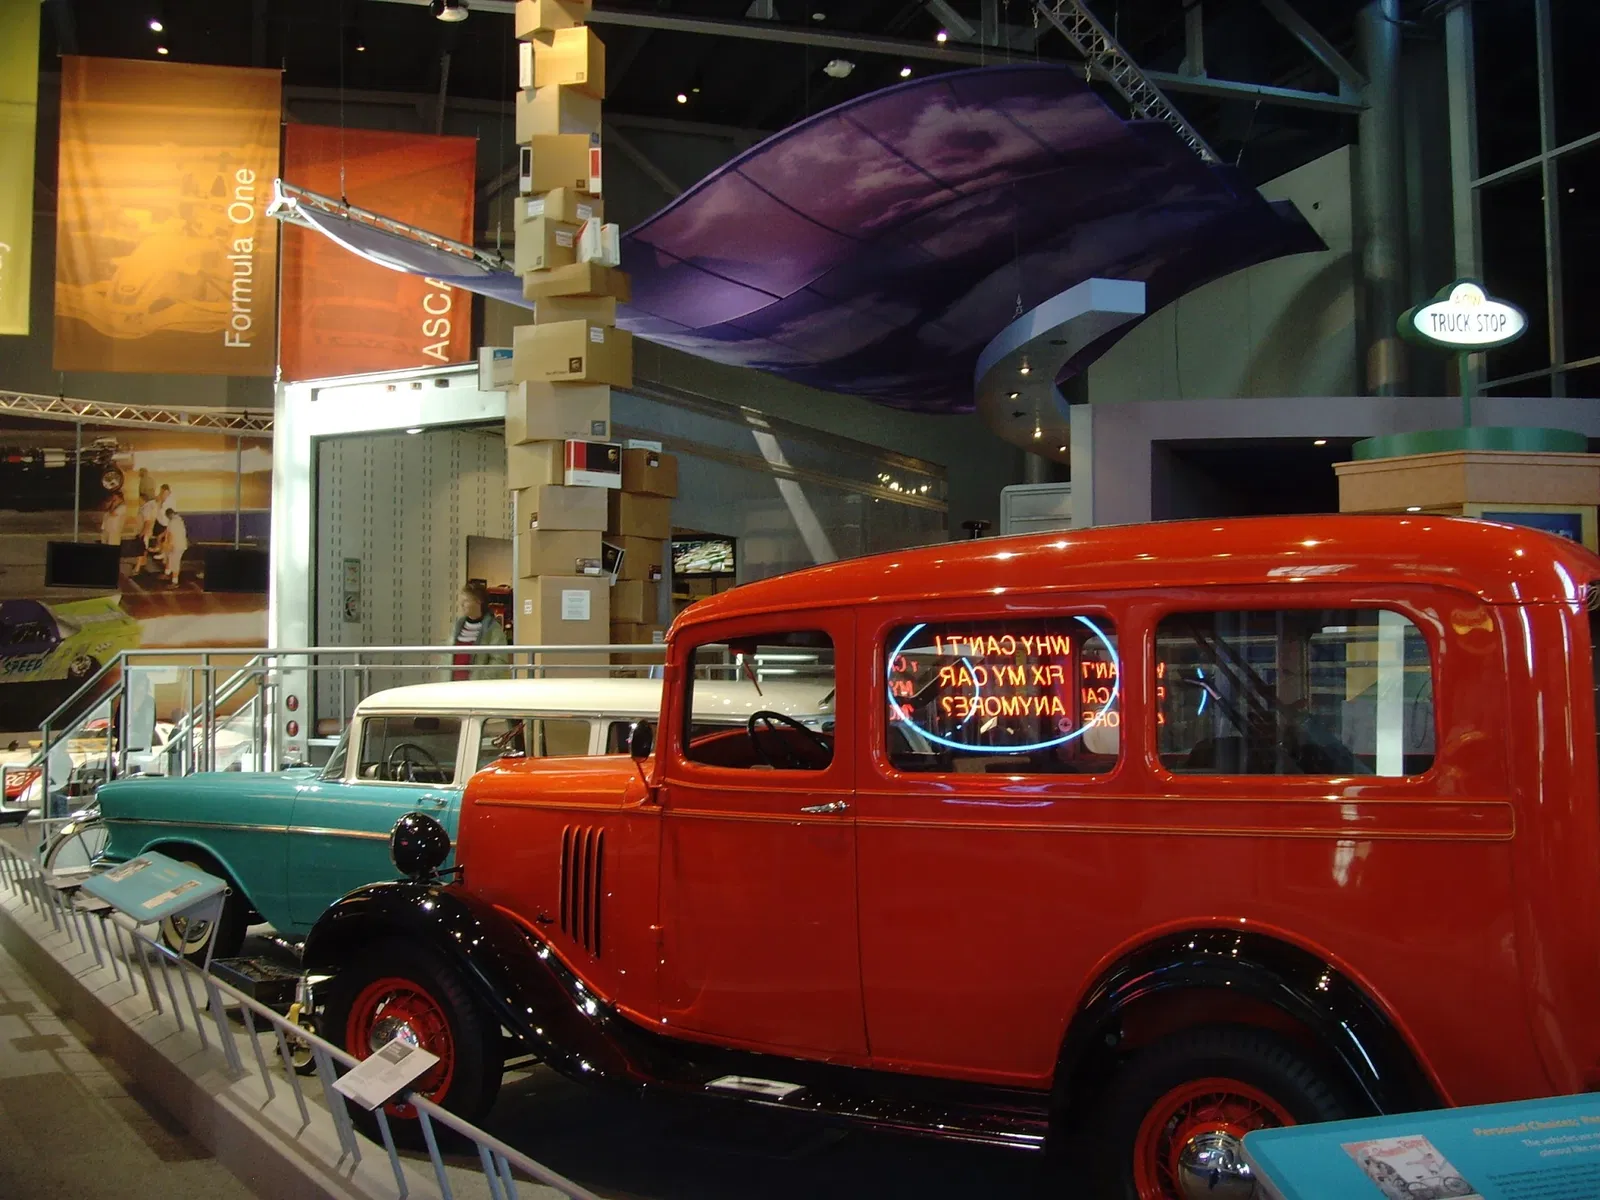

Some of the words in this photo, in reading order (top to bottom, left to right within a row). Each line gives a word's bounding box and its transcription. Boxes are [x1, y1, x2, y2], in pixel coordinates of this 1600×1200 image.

[228, 168, 255, 224] One
[224, 237, 253, 348] Formula
[422, 276, 452, 367] ASCA
[1431, 313, 1471, 332] TRUCK
[1476, 313, 1507, 332] STOP
